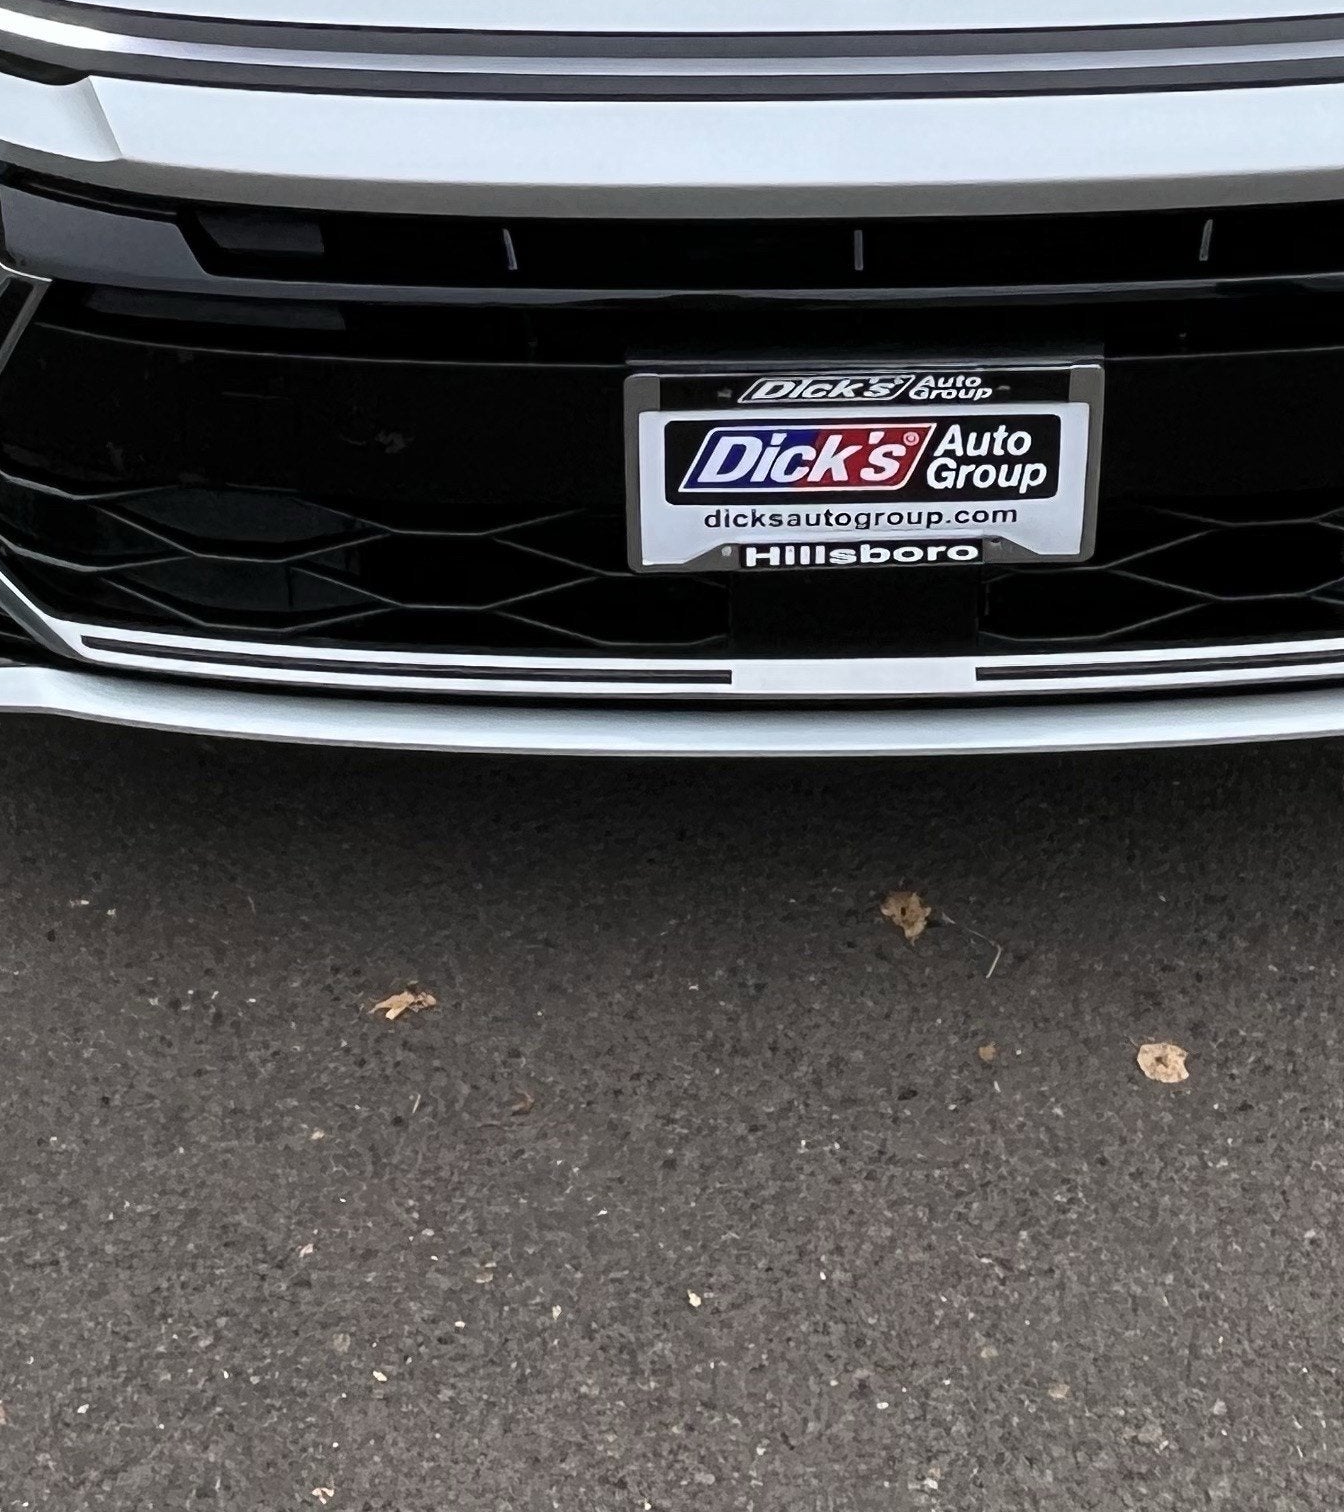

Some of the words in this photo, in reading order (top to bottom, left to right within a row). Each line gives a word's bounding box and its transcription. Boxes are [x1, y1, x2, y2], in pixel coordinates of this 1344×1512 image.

[913, 375, 982, 388] Auto
[908, 387, 993, 401] Group
[698, 431, 906, 483] Dick's
[933, 424, 1032, 457] Auto
[926, 457, 1047, 493] Group
[704, 506, 1018, 530] dicksautogroup.com
[746, 543, 979, 566] Hillsboro
